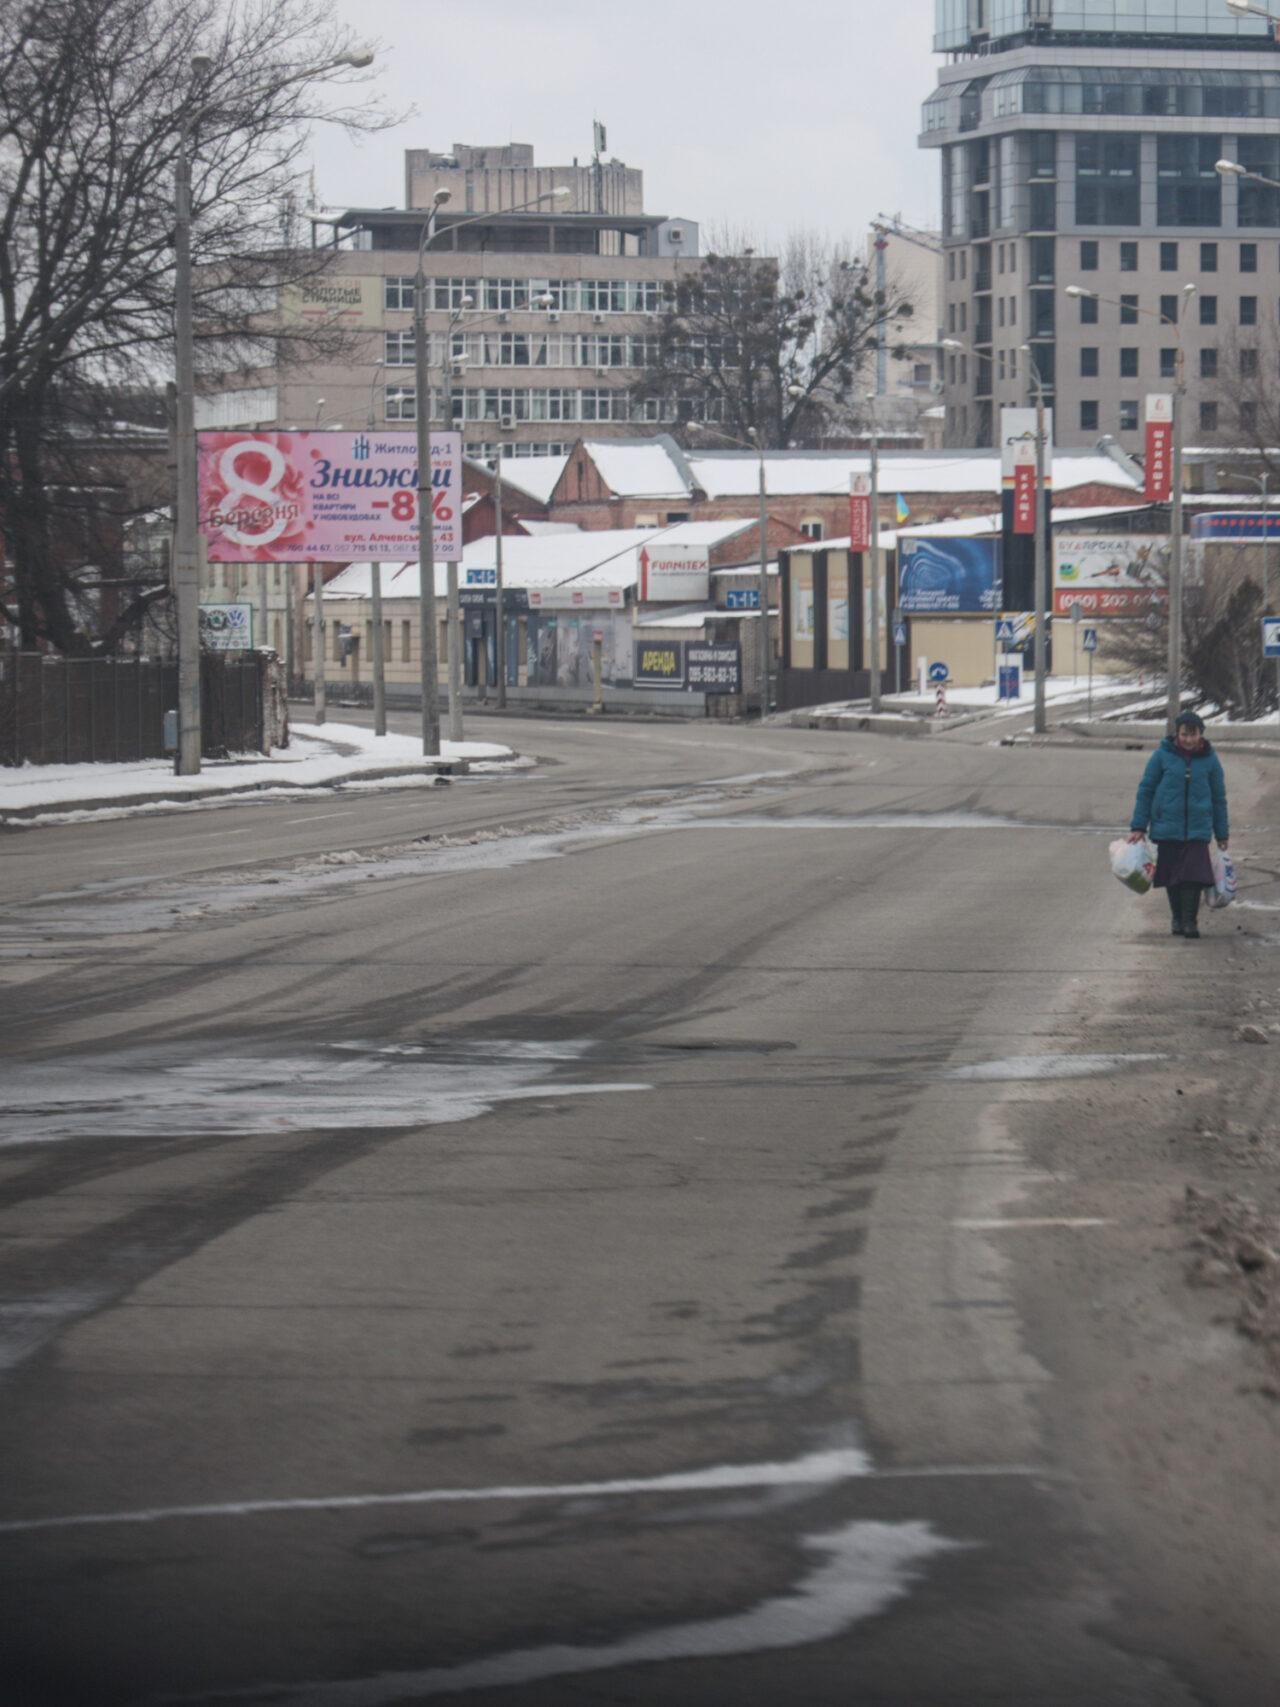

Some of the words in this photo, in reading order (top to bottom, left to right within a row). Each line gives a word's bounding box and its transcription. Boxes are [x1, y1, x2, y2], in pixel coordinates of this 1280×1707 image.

[374, 443, 453, 455] Житлод-1
[219, 440, 286, 546] 8
[344, 533, 365, 543] вул.
[440, 533, 454, 542] 43
[642, 650, 676, 676] АРЕНДА
